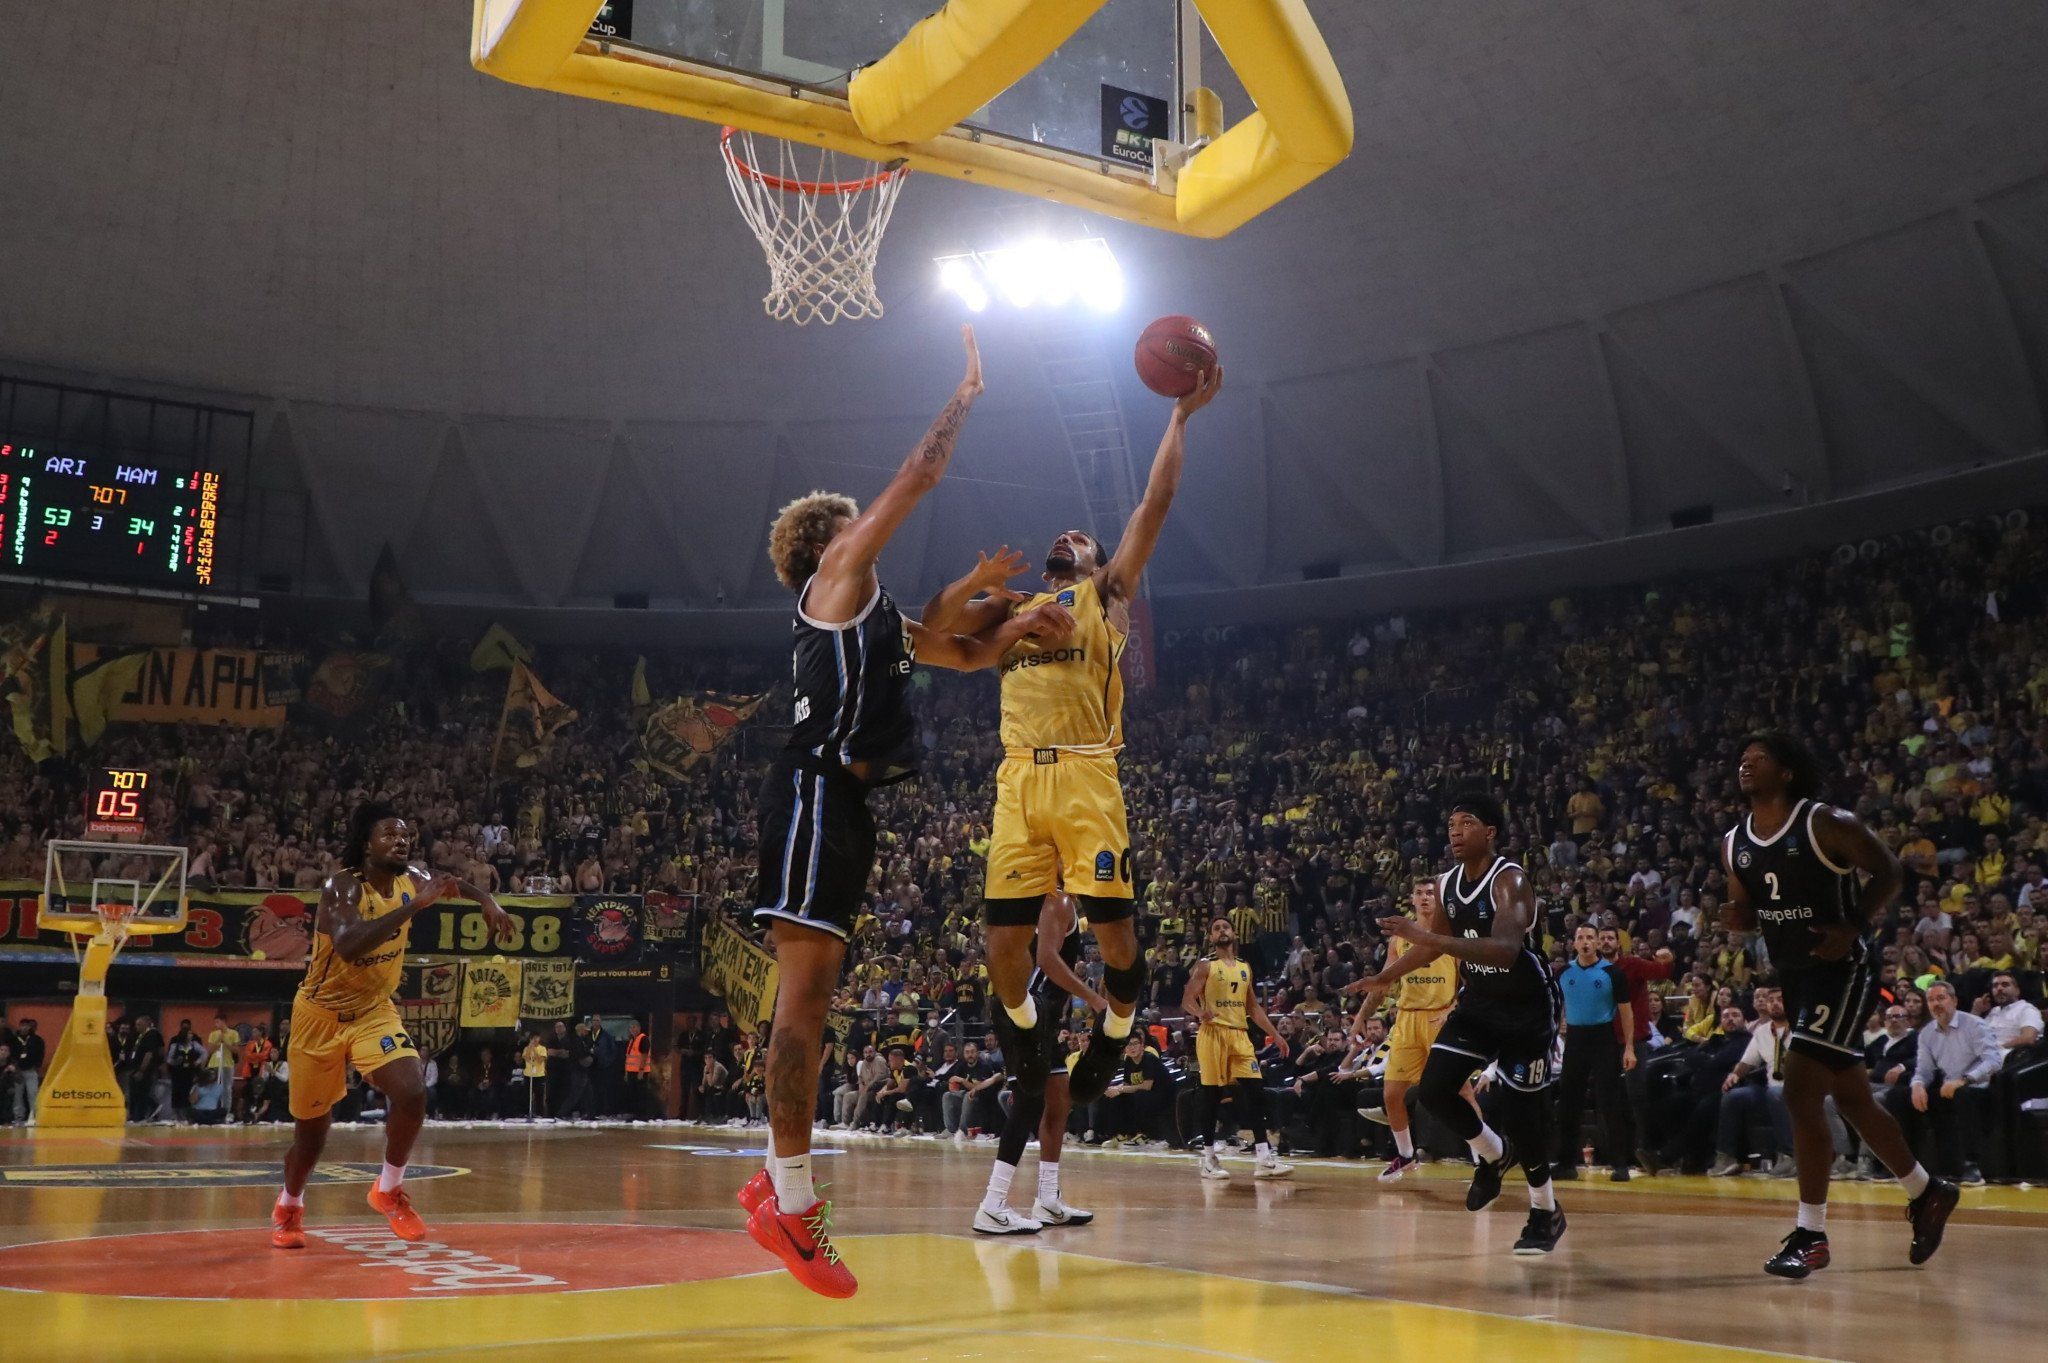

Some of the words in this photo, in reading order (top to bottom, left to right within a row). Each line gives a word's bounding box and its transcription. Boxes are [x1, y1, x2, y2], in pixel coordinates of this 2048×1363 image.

[1112, 145, 1153, 164] EuroCu
[2, 445, 12, 455] 2
[21, 448, 34, 458] 11
[45, 456, 87, 476] ARI
[116, 465, 158, 485] HAM
[203, 472, 219, 482] 01
[176, 478, 185, 489] 5
[203, 482, 218, 491] 02
[89, 485, 127, 505] 7:07
[202, 491, 217, 501] 05
[173, 506, 183, 517] 2
[200, 510, 216, 519] 07
[43, 507, 71, 527] 53
[128, 517, 154, 536] 34
[91, 515, 103, 530] 3
[200, 519, 215, 529] 08
[173, 524, 181, 535] 7
[203, 529, 215, 538] 19
[45, 530, 59, 545] 2
[171, 534, 180, 544] 4
[137, 542, 144, 555] 1
[170, 544, 180, 553] 4
[198, 547, 213, 557] 43
[169, 553, 179, 563] 3
[197, 556, 212, 566] 44
[169, 562, 178, 573] 9
[1036, 750, 1054, 764] ARIS
[108, 771, 148, 789] 7:07
[96, 791, 139, 817] 0.5
[91, 823, 137, 833] betsson
[1764, 872, 1781, 900] 2
[1757, 905, 1813, 925] nexperia
[185, 908, 223, 948] 3
[438, 911, 562, 953] 1988
[662, 928, 687, 939] BLOCK
[525, 963, 548, 973] ARIS
[1407, 975, 1446, 984] etsson
[1230, 982, 1239, 994] 7
[521, 1003, 574, 1016] ANTINAZI
[1808, 1004, 1831, 1034] 2
[1528, 1058, 1545, 1085] 19
[52, 1089, 112, 1100] betsson
